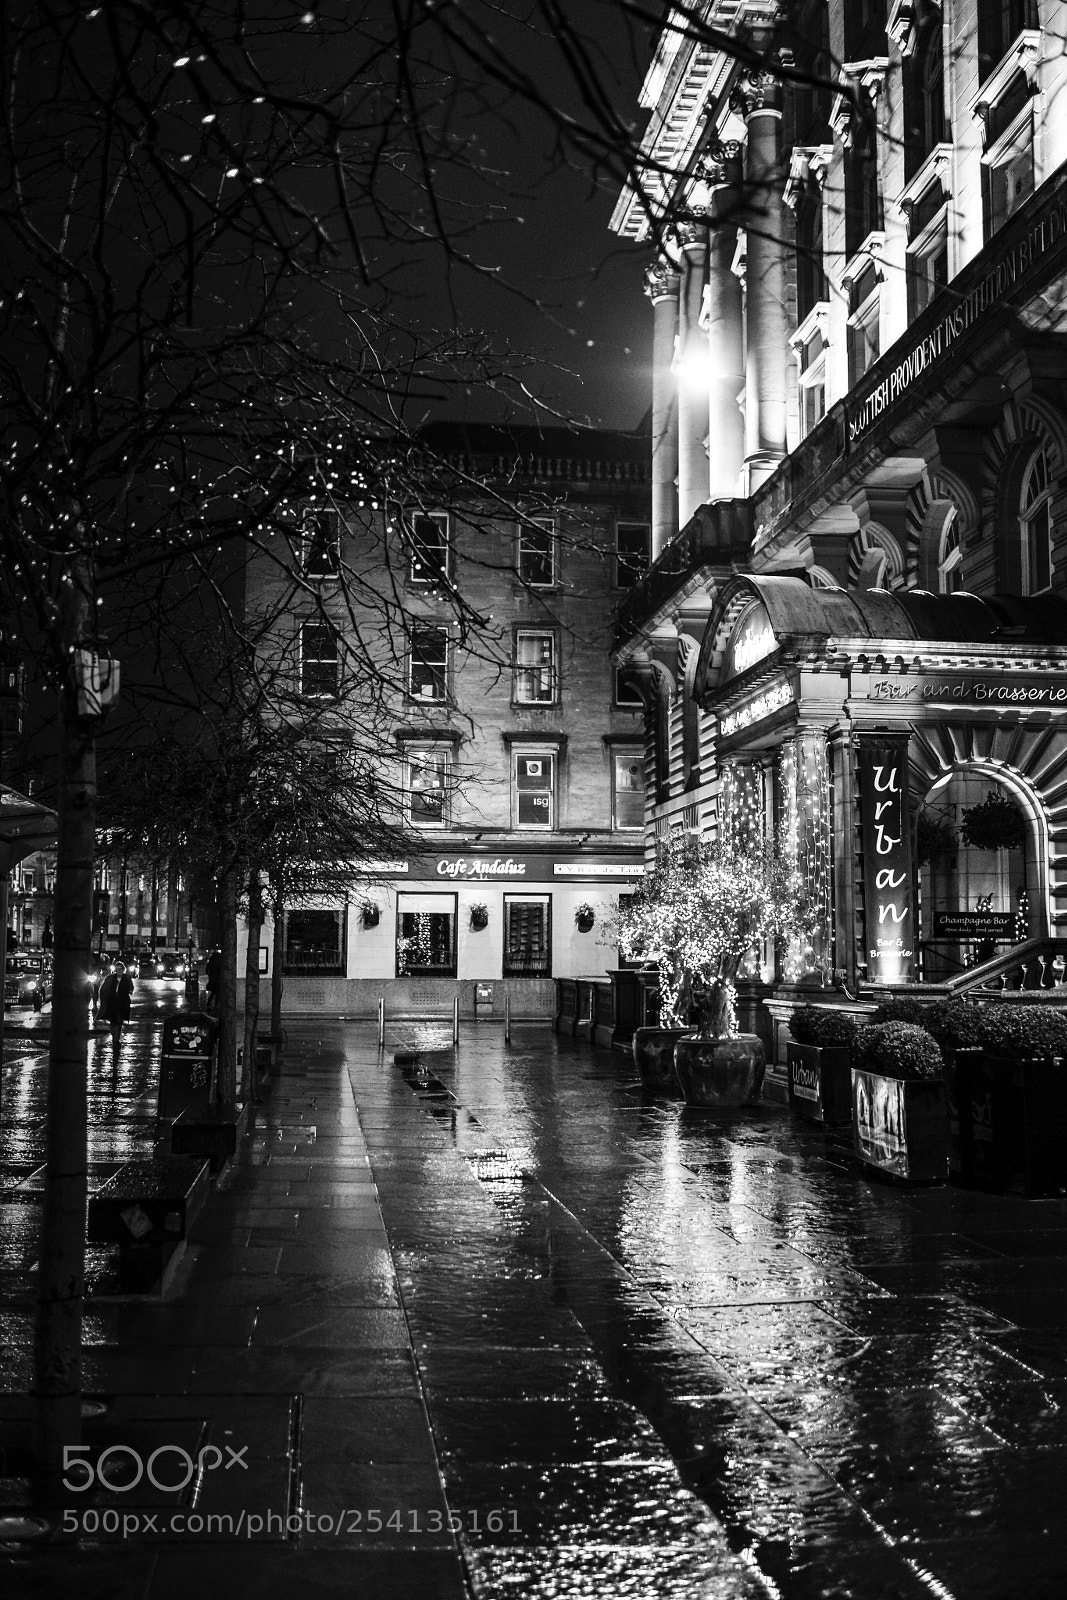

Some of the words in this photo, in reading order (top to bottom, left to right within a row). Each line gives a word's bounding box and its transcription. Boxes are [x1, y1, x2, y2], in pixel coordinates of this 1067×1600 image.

[850, 378, 889, 440] SCOTTISH
[890, 323, 943, 402] PROVIDENT
[945, 256, 1016, 348] INSTITUTION
[923, 681, 970, 697] and
[973, 683, 1067, 701] Brasserie
[436, 858, 467, 877] Cafe
[468, 858, 526, 875] Andaluz
[939, 915, 992, 926] Champagne
[993, 916, 1010, 925] Bar
[876, 938, 895, 947] Bar
